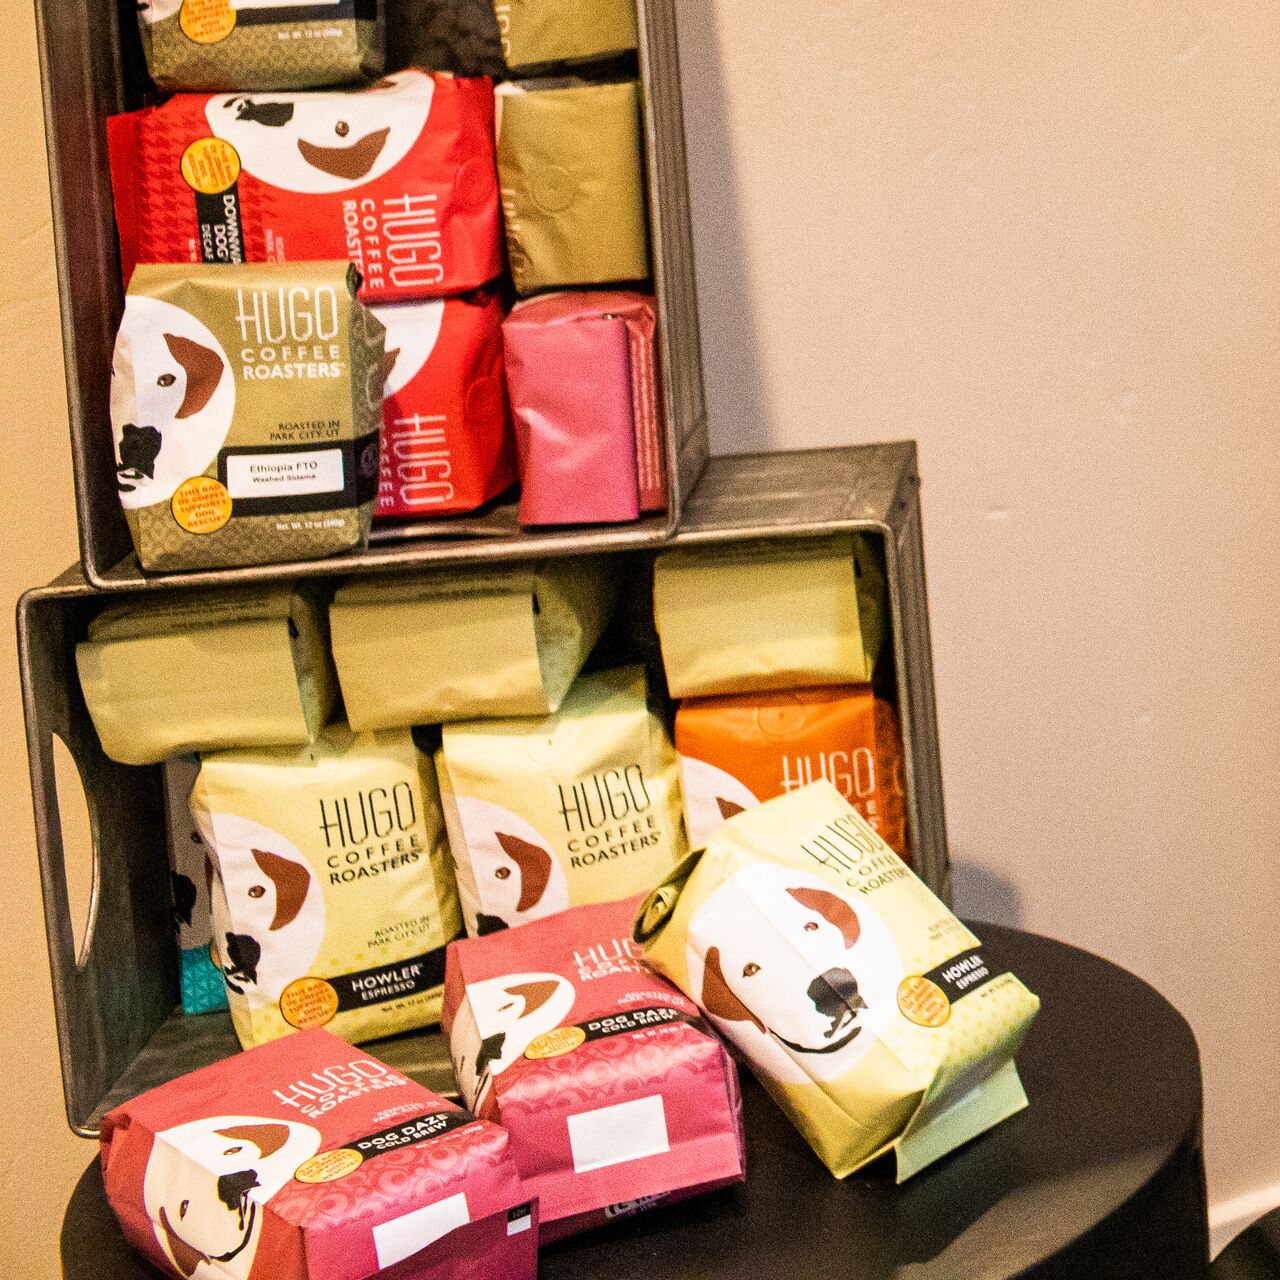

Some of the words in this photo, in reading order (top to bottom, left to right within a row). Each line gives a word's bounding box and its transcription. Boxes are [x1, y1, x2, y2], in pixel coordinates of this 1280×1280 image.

[361, 198, 385, 289] COFFEE
[382, 194, 444, 287] HUGO
[235, 284, 339, 343] HUGO
[242, 345, 340, 362] COFFEE
[244, 361, 341, 380] ROASTERS
[278, 421, 325, 431] ROASTED
[250, 463, 293, 474] Ethiopia
[296, 461, 318, 471] FTO
[394, 413, 453, 506] HUGO
[179, 499, 228, 513] SUPPORTS
[319, 781, 416, 848] HUGO
[558, 763, 652, 833] HUGO
[567, 813, 657, 852] COFFEE
[801, 812, 886, 875] HUGO
[327, 835, 418, 868] COFFEE
[329, 849, 419, 885] ROASTERS
[570, 833, 660, 869] ROASTERS
[351, 965, 419, 992] HOWLER
[361, 979, 416, 1000] ESPRESSO
[272, 1060, 388, 1108] HUGO
[308, 1079, 407, 1119] ROASTERS
[358, 1132, 400, 1150] DOG
[401, 1113, 449, 1135] DAZE
[415, 1120, 446, 1138] BREW
